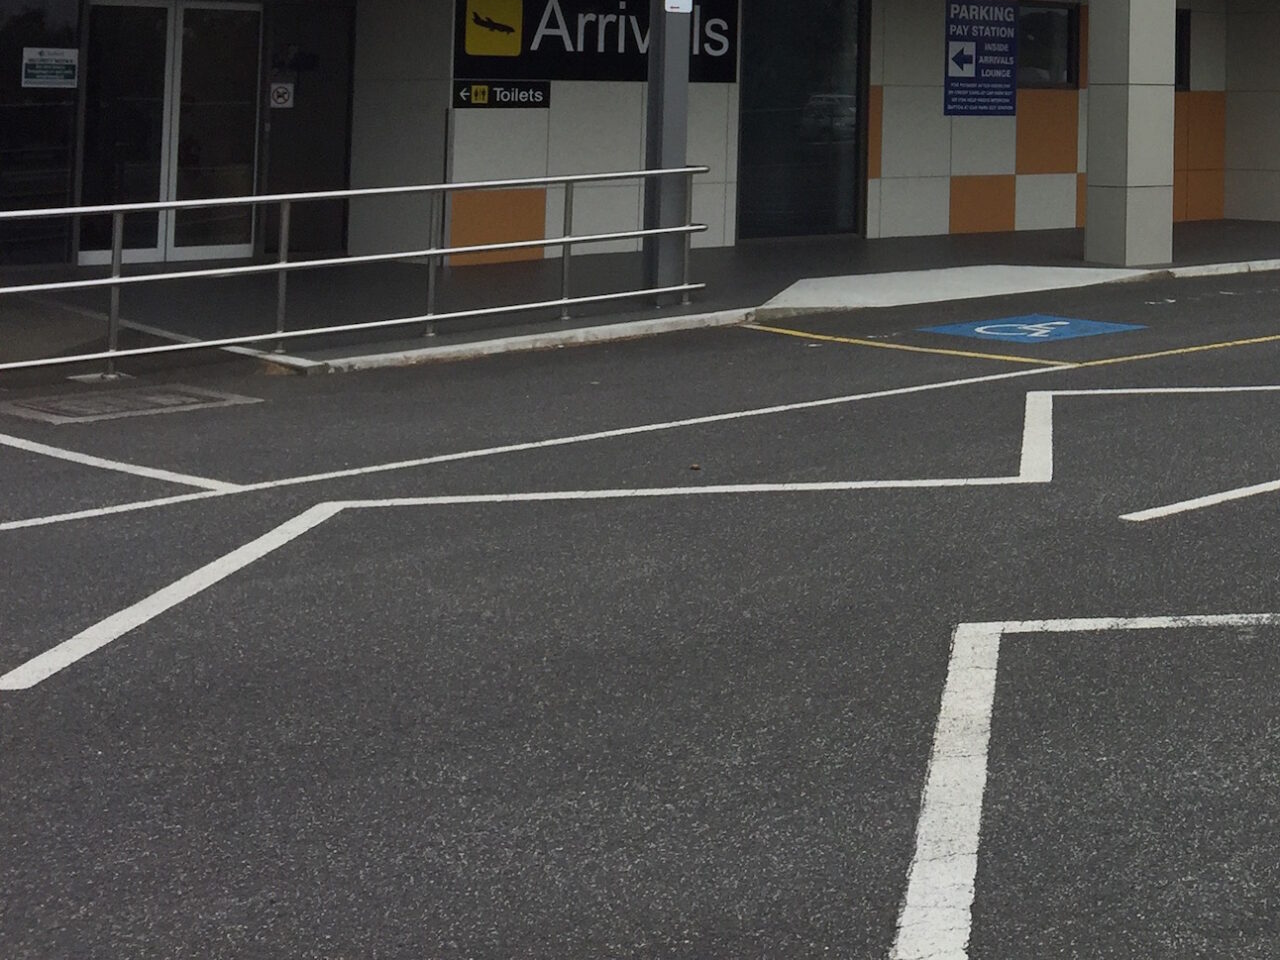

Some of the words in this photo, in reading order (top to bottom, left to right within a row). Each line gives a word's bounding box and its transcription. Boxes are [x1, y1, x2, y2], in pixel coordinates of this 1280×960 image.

[950, 3, 1015, 22] PARKING
[949, 24, 969, 36] PAY
[971, 25, 1015, 38] STATION
[984, 42, 1009, 52] INSIDE
[979, 55, 1014, 65] ARRIVALS
[981, 68, 1012, 78] LOUNGE
[493, 87, 543, 103] Toilets
